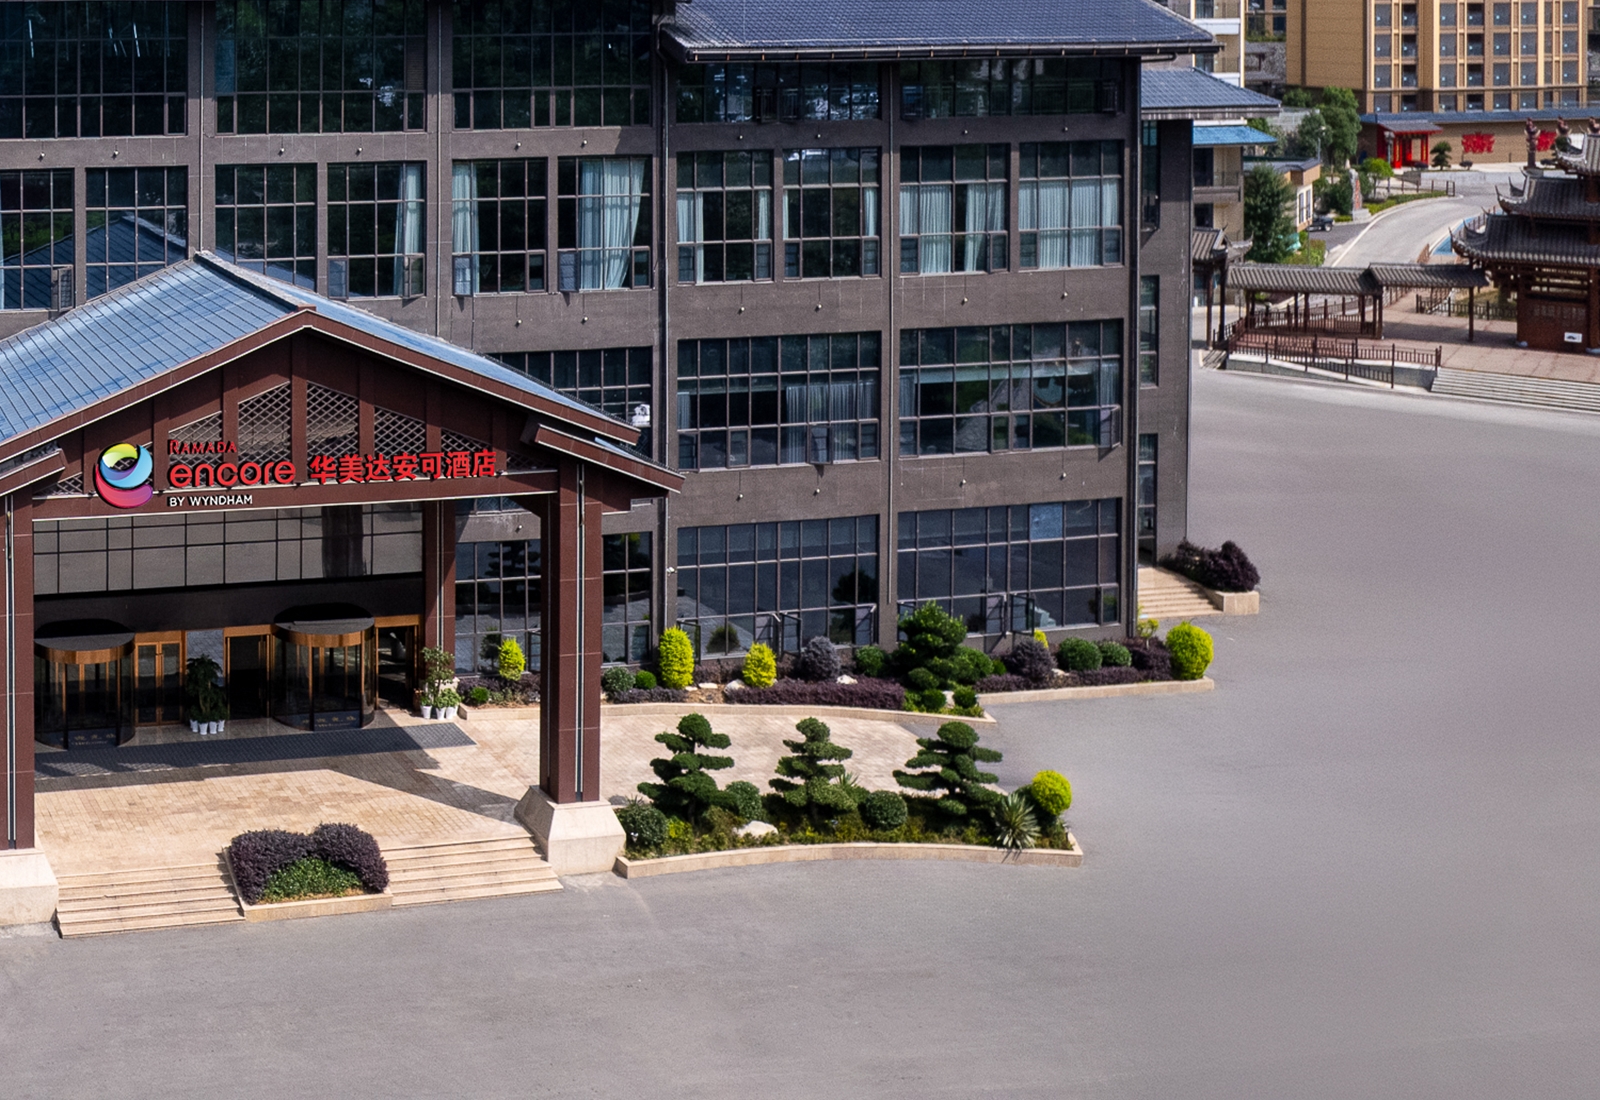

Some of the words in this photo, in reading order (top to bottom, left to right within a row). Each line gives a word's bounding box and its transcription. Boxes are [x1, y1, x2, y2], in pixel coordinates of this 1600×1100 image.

[168, 439, 237, 454] RAMADA
[169, 460, 296, 488] encore
[309, 448, 497, 485] 华美达安可酒店
[169, 496, 185, 507] BY
[189, 494, 253, 506] WYNDHAM
